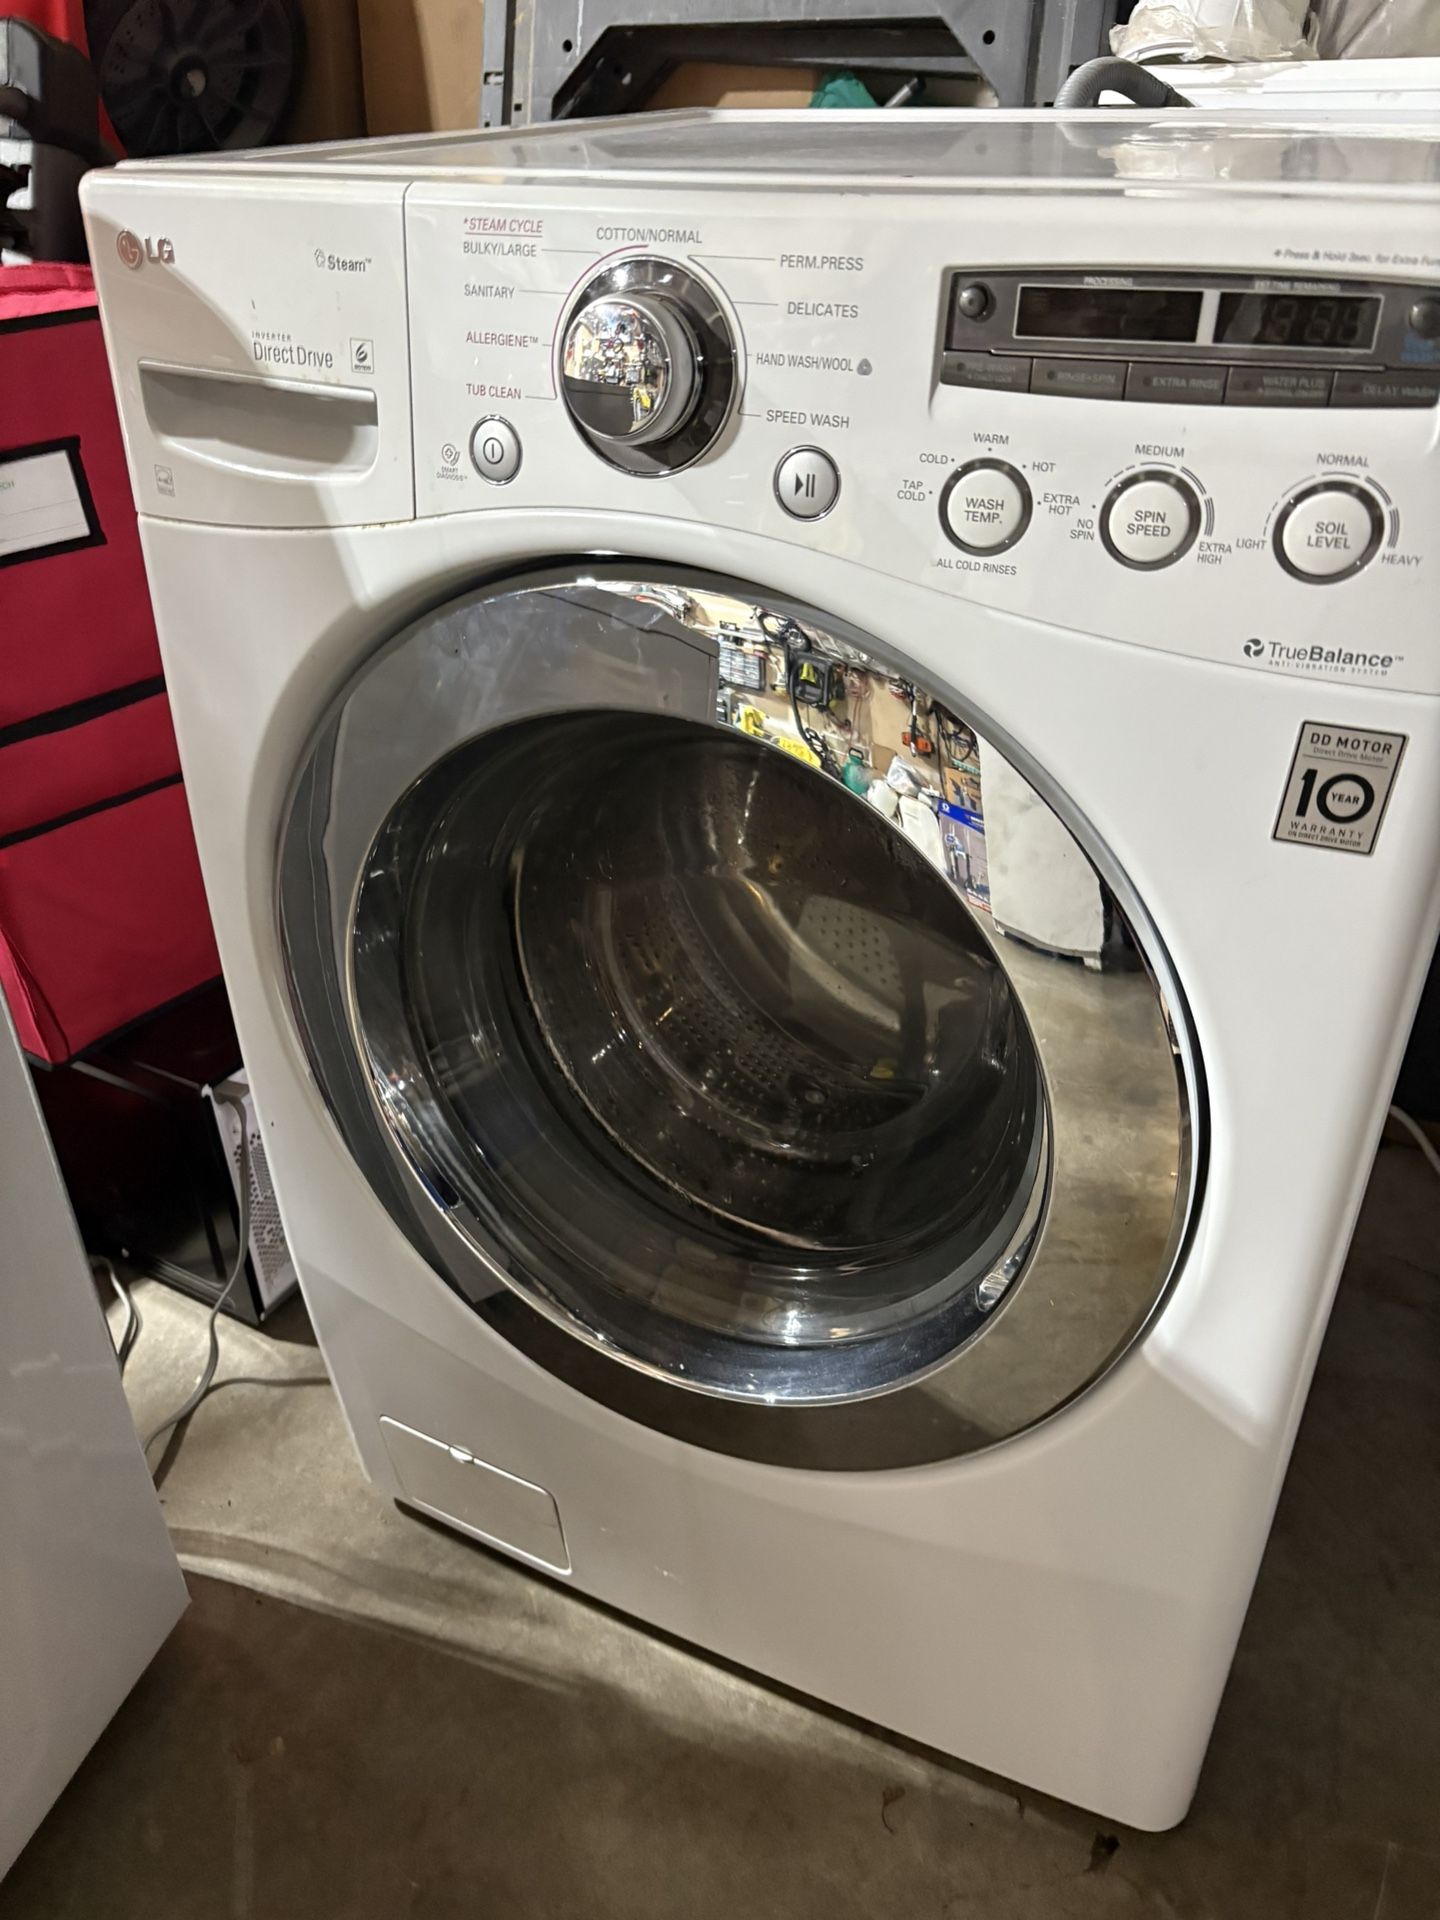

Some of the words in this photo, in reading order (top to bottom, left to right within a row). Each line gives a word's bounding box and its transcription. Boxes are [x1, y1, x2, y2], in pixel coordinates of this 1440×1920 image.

[508, 219, 543, 233] CYCLE
[596, 227, 703, 244] COTTON/NORMAL
[144, 236, 175, 264] LG
[463, 241, 537, 257] BULKY/LARGE
[780, 254, 864, 271] PERM.PRESS
[464, 285, 514, 299] SANITARY
[787, 301, 859, 318] DELICATES
[252, 330, 291, 342] INVERTER
[756, 352, 786, 367] HAND
[787, 354, 853, 372] WASH/WOOL
[1152, 376, 1186, 388] EXTRA
[1189, 378, 1220, 390] RINSE
[1262, 375, 1296, 387] WATER
[1299, 377, 1325, 388] PLUS
[466, 383, 486, 396] TUB
[489, 385, 521, 399] CLEAN
[1362, 382, 1399, 396] DELAY
[766, 409, 807, 425] SPEED
[809, 413, 850, 429] WASH
[973, 432, 1009, 445] WARM
[1134, 444, 1185, 457] MEDIUM
[919, 453, 948, 464] COLD
[1316, 453, 1370, 468] NORMAL
[1032, 461, 1056, 473] HOT
[902, 479, 923, 490] TAP
[897, 490, 926, 501] COLD
[1043, 493, 1080, 506] EXTRA
[965, 497, 1005, 510] WASH
[1049, 505, 1072, 516] HOT
[964, 510, 1003, 524] TEMP.
[1134, 510, 1166, 523] SPIN
[1077, 519, 1094, 529] NO
[1126, 523, 1171, 537] SPEED
[1315, 521, 1348, 535] SOIL
[1069, 530, 1095, 541] SPIN
[1307, 535, 1351, 549] LEVEL
[1198, 541, 1232, 554] EXTRA
[1236, 538, 1267, 550] LIGHT
[1197, 553, 1222, 565] HIGH
[1381, 553, 1423, 567] HEAVY
[936, 558, 953, 569] ALL
[955, 559, 981, 572] COLD
[982, 563, 1017, 576] RINSES
[1310, 732, 1331, 746] DD
[1336, 736, 1392, 755] MOTOR
[1313, 746, 1336, 757] Direct
[1338, 749, 1358, 760] Drive
[1295, 767, 1375, 824] 10
[1331, 791, 1360, 805] YEAR
[1290, 820, 1364, 839] WARRANTY
